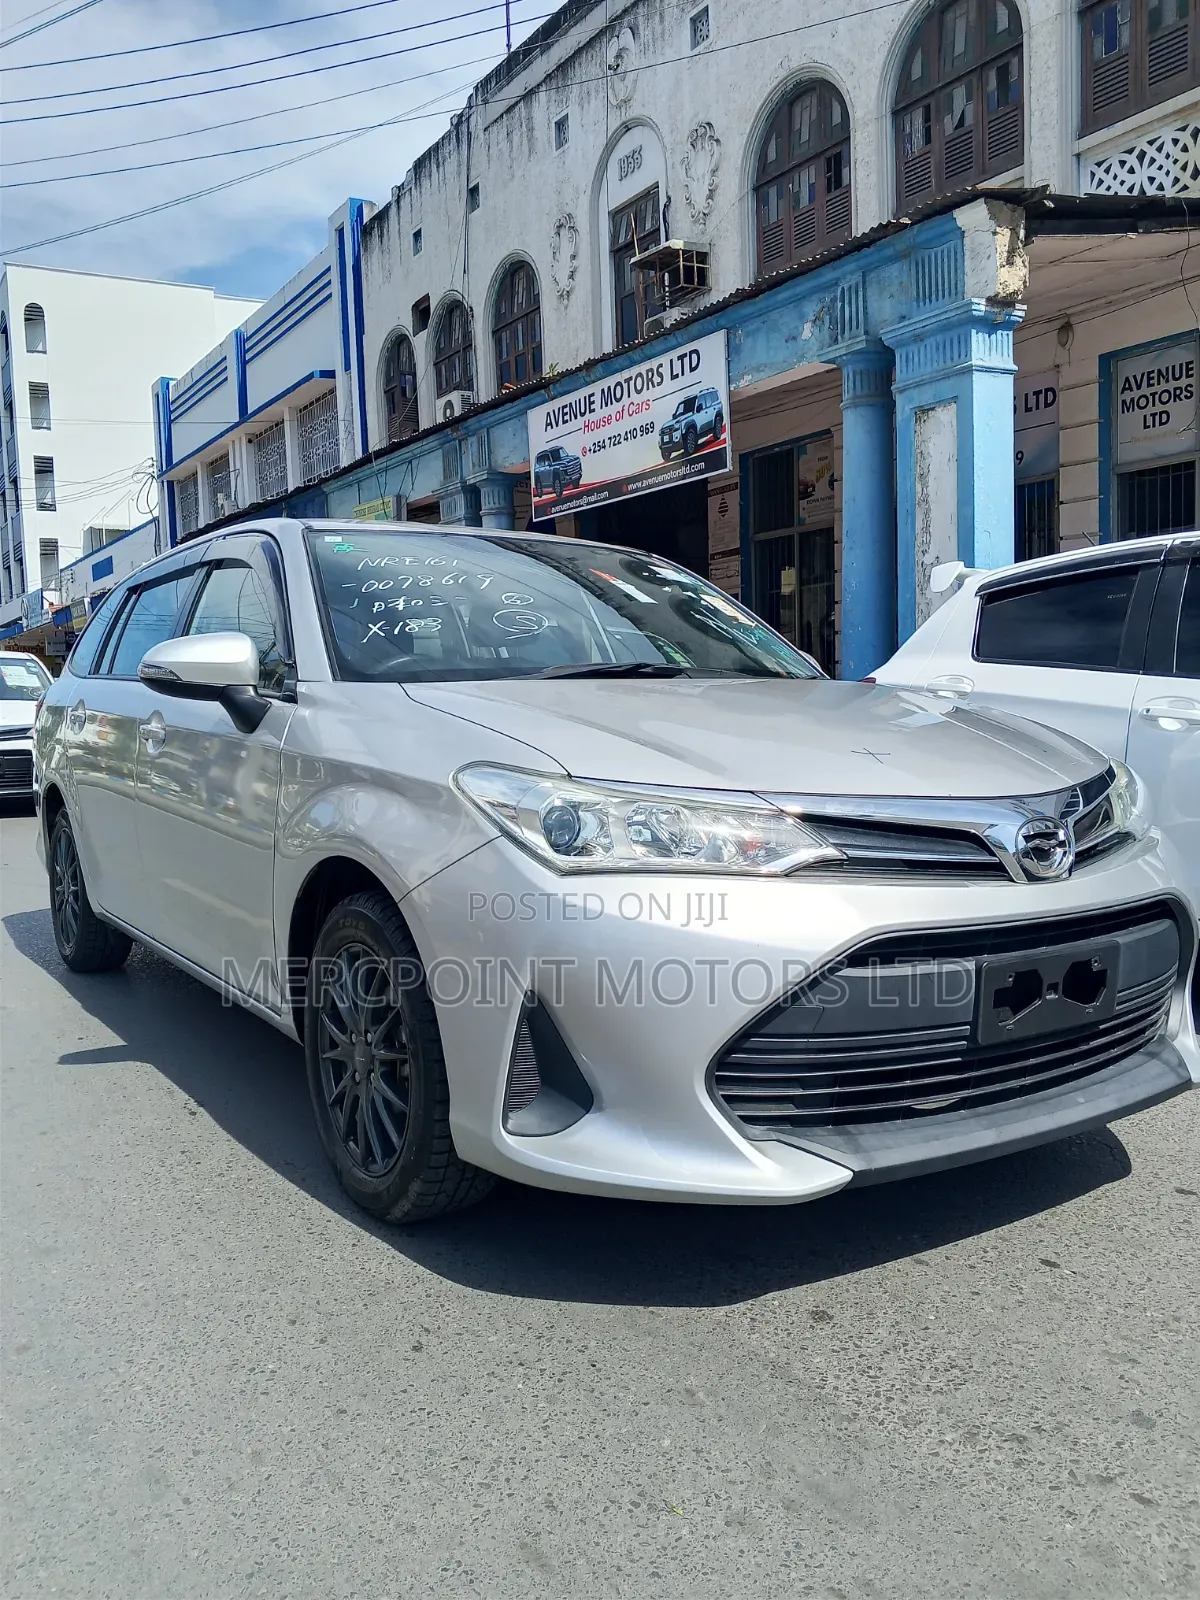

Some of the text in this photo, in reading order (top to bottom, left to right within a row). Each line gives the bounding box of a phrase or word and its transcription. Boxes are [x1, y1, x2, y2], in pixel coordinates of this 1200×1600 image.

[544, 348, 701, 432] AVENUE MOTORS LTD
[1120, 360, 1195, 394] AVENUE
[1024, 387, 1057, 413] LTD
[1121, 383, 1194, 414] MOTORS
[582, 398, 651, 434] House of Cars
[1142, 410, 1171, 430] LTD
[588, 420, 655, 454] +254 722 410 969
[627, 461, 705, 491] www.avenuemotorsltd.com
